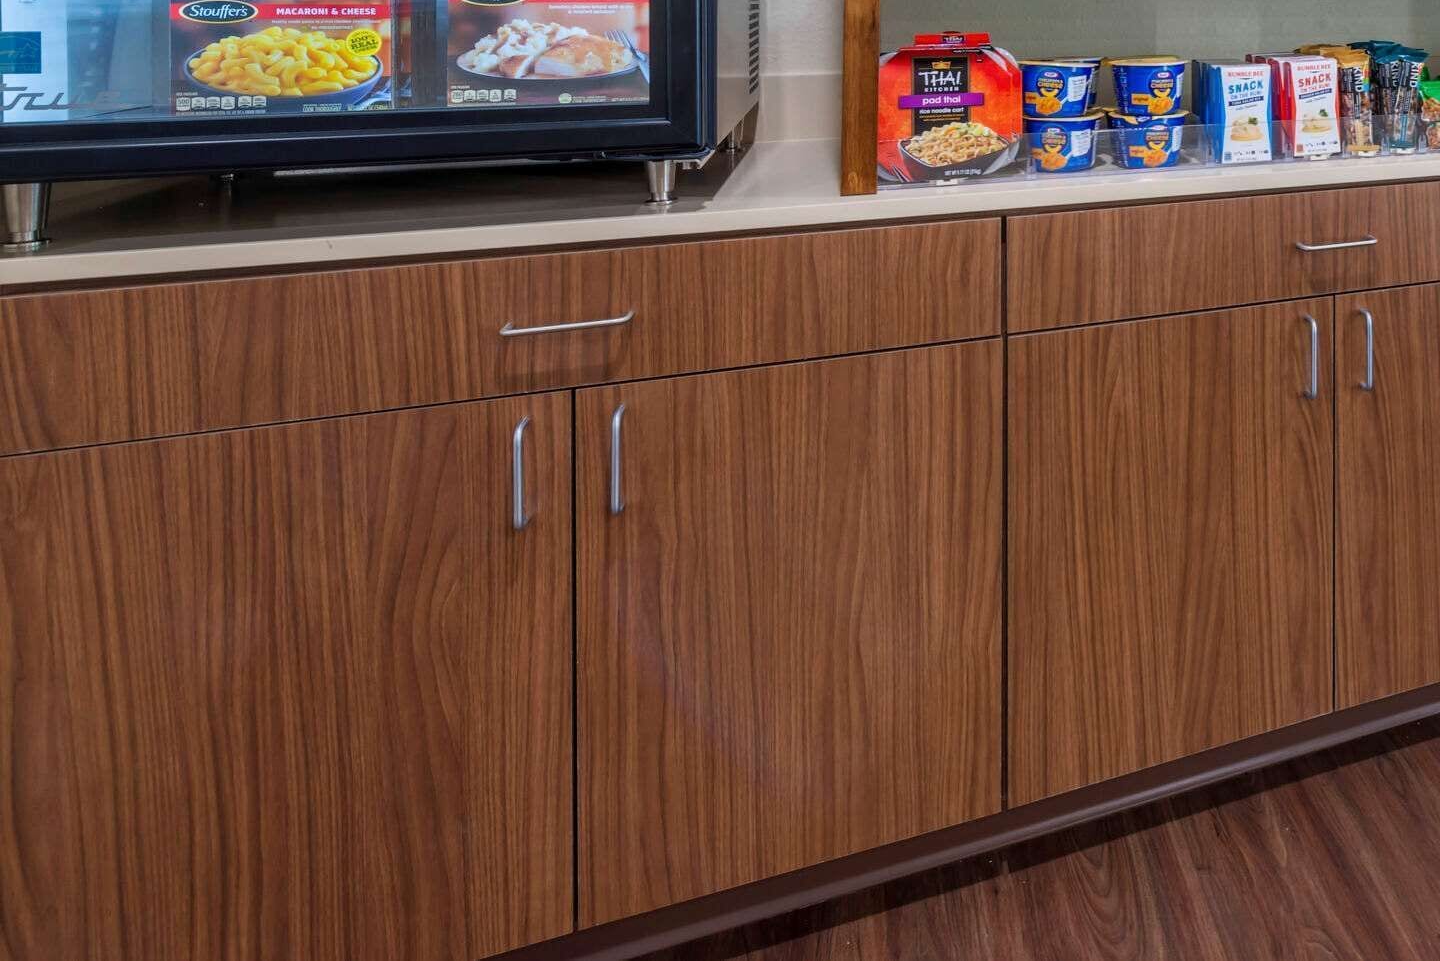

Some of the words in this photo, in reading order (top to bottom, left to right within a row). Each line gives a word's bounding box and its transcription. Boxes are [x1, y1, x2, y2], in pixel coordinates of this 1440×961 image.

[189, 4, 248, 20] Stouffer's
[276, 7, 329, 16] MACARONI
[331, 7, 339, 16] &
[342, 7, 377, 16] CHEESE
[918, 71, 962, 86] THAI
[1298, 73, 1332, 87] SNACK
[1353, 67, 1363, 93] KIND
[1409, 62, 1419, 88] KIND
[1228, 80, 1264, 94] SNACK
[922, 96, 941, 106] pad
[943, 95, 961, 104] thai
